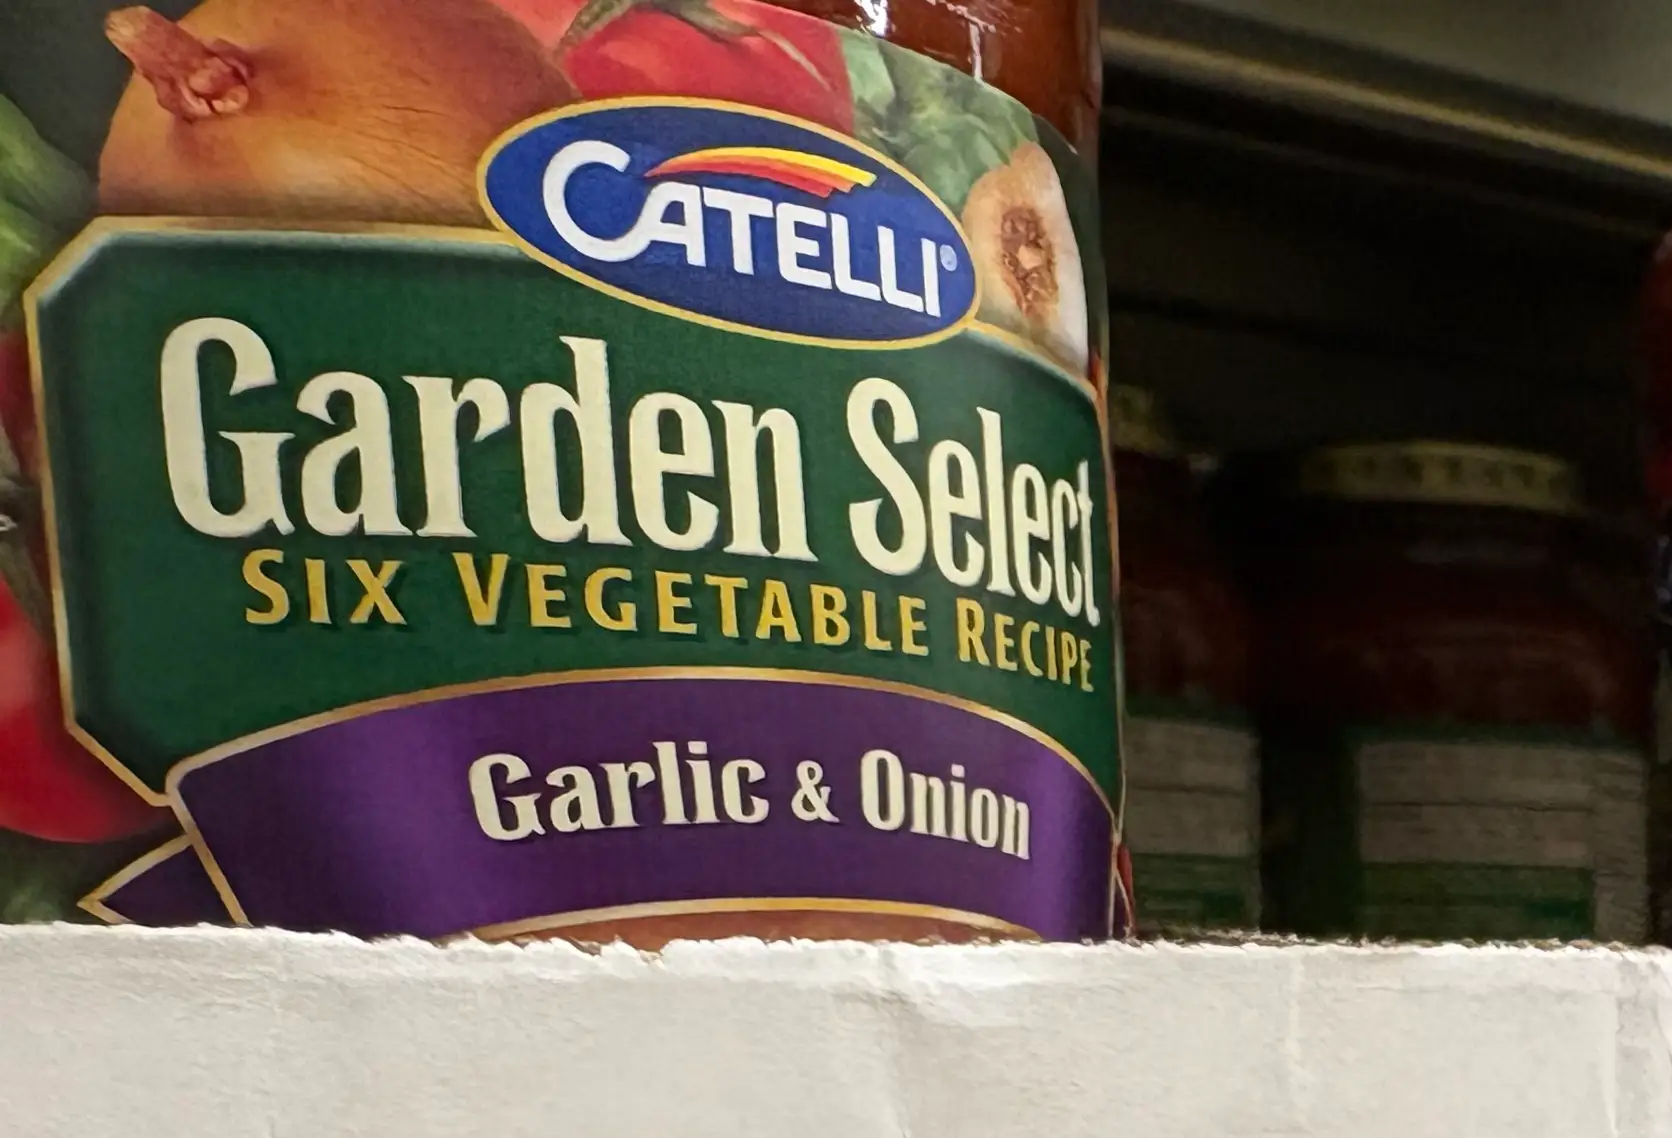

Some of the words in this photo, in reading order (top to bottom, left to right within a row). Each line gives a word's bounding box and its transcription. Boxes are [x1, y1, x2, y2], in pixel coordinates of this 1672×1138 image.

[542, 140, 941, 317] CATELLI
[160, 316, 818, 562] Garden
[846, 378, 1099, 626] Select
[242, 549, 407, 625] SIX
[456, 553, 930, 657] VEGETABLE
[957, 609, 1095, 692] RECIPE
[468, 740, 769, 842] Garlic
[790, 758, 840, 823] &
[860, 748, 1032, 860] Onion
